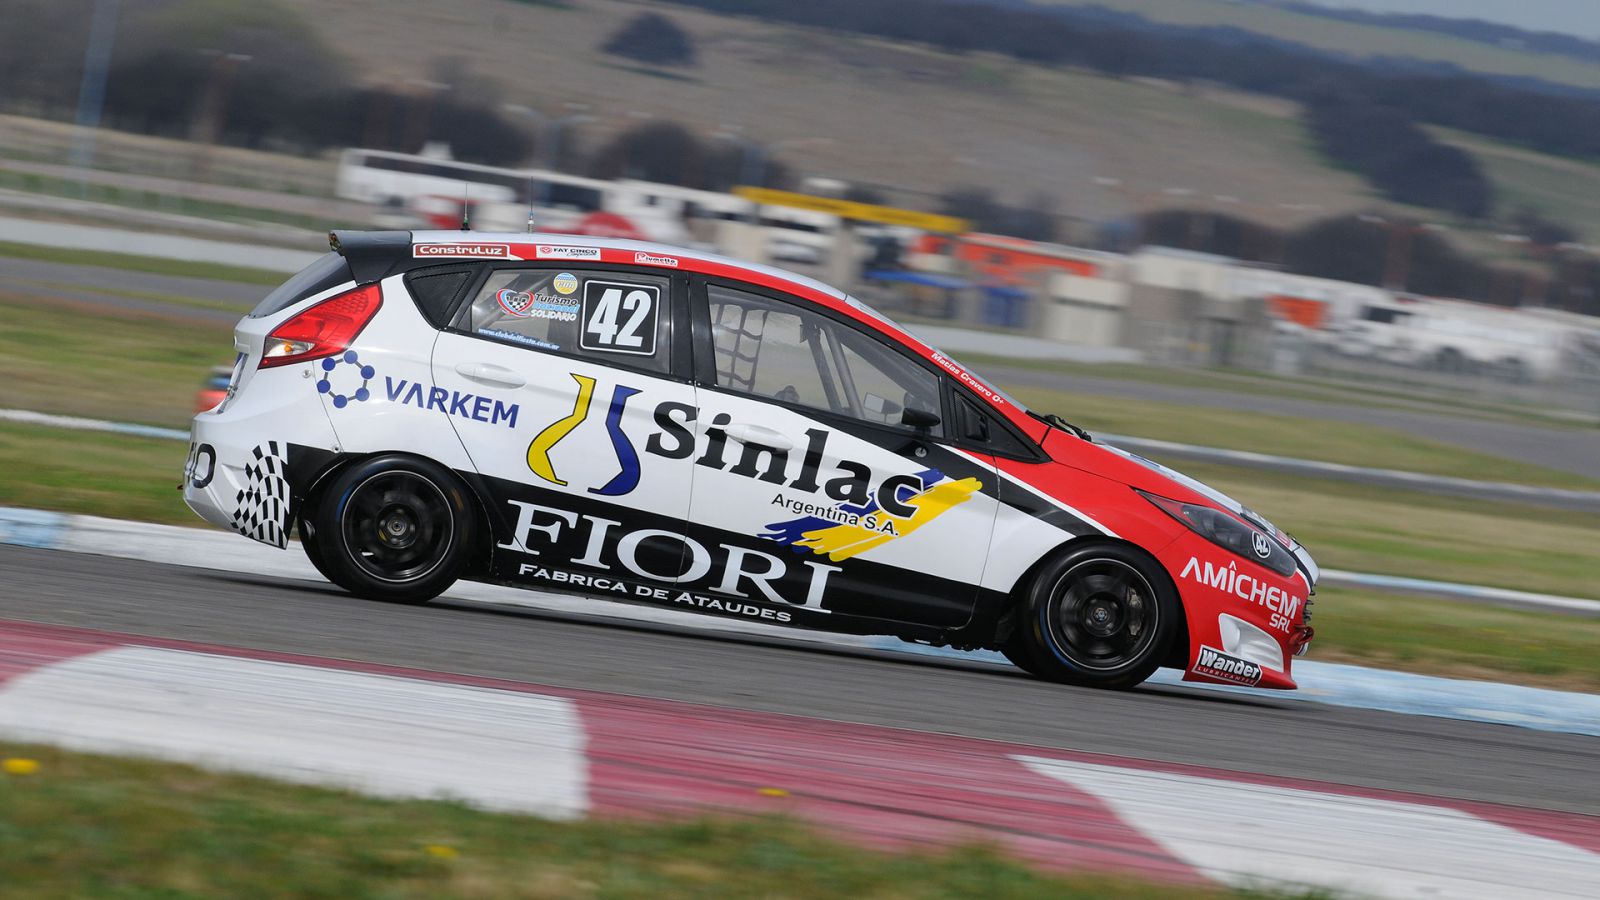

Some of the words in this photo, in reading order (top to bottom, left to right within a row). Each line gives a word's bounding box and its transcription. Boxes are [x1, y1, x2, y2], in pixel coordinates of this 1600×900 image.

[420, 246, 502, 255] ConstruLuz
[535, 293, 578, 306] Turismo
[530, 309, 577, 321] SOLIDARIO
[587, 288, 651, 347] 42
[960, 372, 992, 397] Cravero
[385, 376, 519, 429] VARKEM
[644, 401, 924, 518] Sinlac
[772, 493, 859, 526] Argentina
[862, 514, 899, 537] S.A.
[497, 500, 843, 615] FIORI
[1256, 534, 1268, 554] 42
[518, 563, 630, 594] FABRICA
[636, 585, 670, 602] DE
[674, 592, 792, 623] ATAUDES
[1269, 613, 1290, 634] SRL
[1200, 650, 1259, 679] Wander
